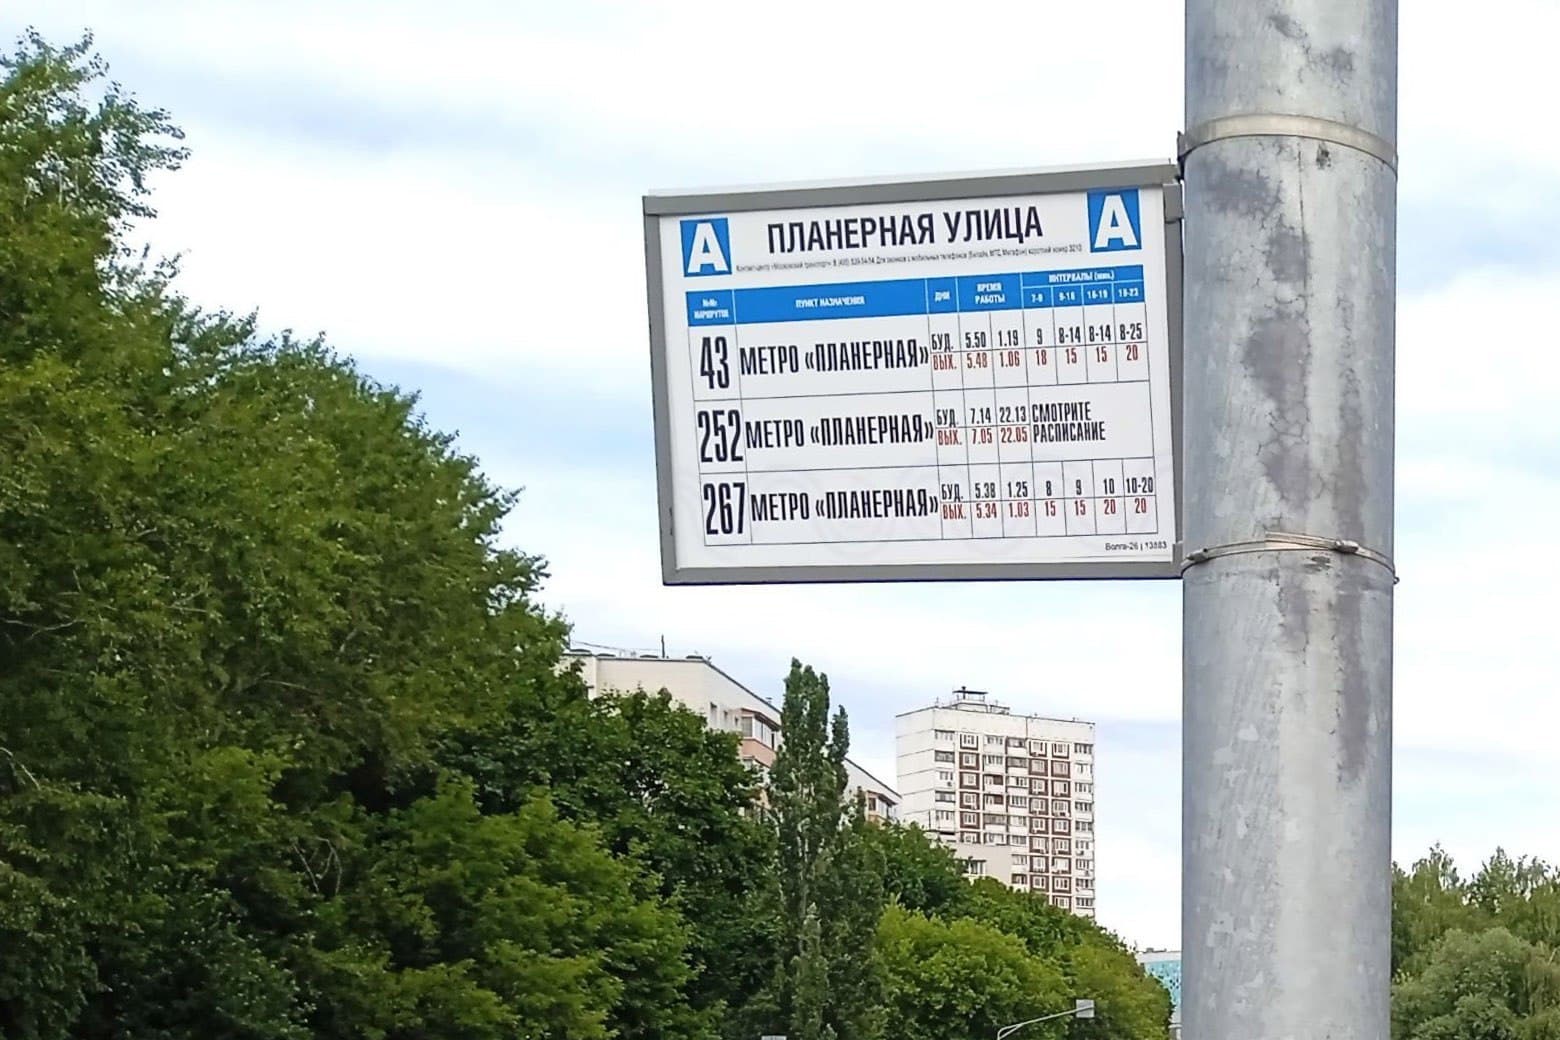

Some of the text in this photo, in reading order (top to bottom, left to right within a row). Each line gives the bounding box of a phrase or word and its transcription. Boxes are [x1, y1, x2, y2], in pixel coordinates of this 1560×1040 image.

[768, 206, 1043, 254] ПЛАНЕРНАЯ УЛИЦА
[931, 323, 1143, 351] БУД. 5.50 1.19 9 8-14 8-14 8-25
[700, 336, 929, 390] 43 МЕТРО «ПЛАНЕРНАЯ»
[933, 353, 957, 371] ВЫХ.
[999, 350, 1020, 367] 1.06
[1036, 349, 1047, 366] 18
[1066, 348, 1078, 364] 15
[1096, 346, 1108, 363] 15
[1126, 344, 1139, 361] 20
[936, 401, 1092, 426] БУД. 7.14 22.13 СМОТРИТЕ
[697, 409, 934, 463] 252 МЕТРО «ПЛАНЕРНАЯ»
[938, 420, 1106, 446] ВЫХ. 7.05 22.05 РАСПИСАНИЕ
[941, 477, 1153, 501] БУД. 5.38 1.25 8 9 10 10-20
[702, 482, 939, 536] 267 МЕТРО «ПЛАНЕРНАЯ»
[942, 497, 1147, 520] ВЫХ. 5.34 1.03 15 15 20 20
